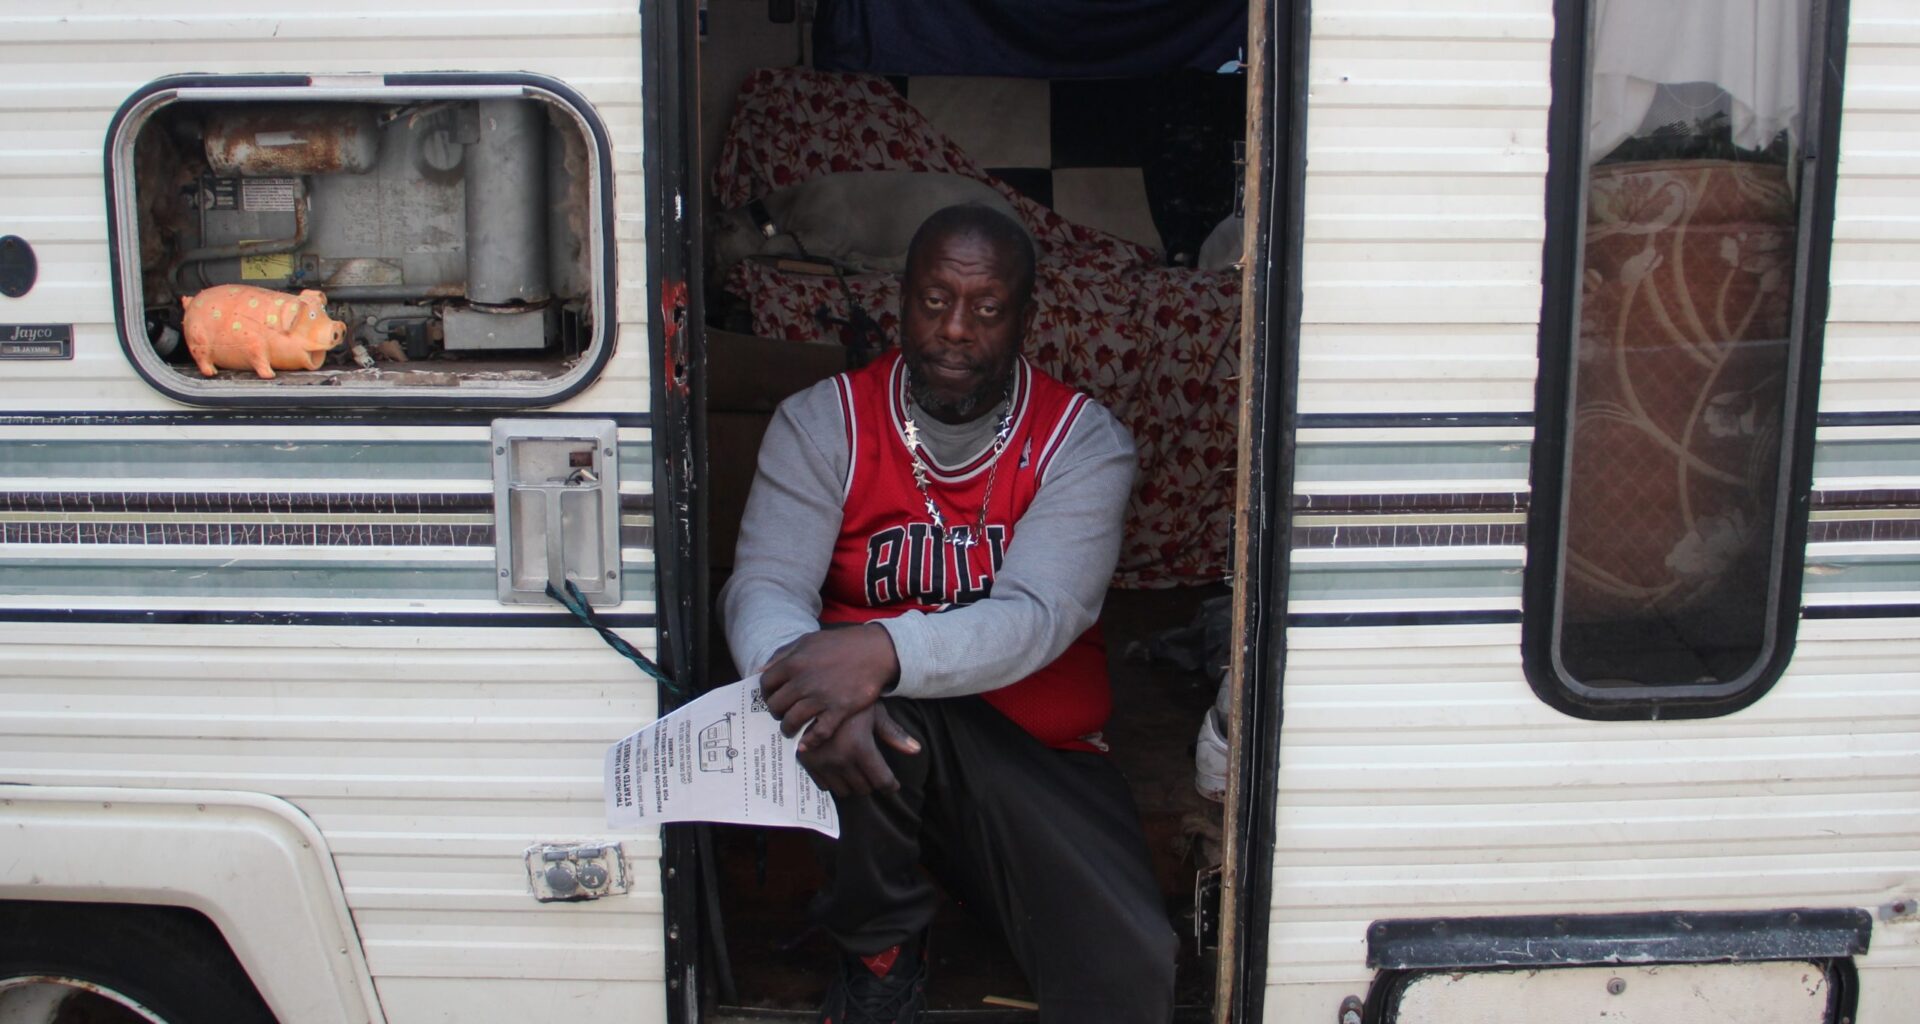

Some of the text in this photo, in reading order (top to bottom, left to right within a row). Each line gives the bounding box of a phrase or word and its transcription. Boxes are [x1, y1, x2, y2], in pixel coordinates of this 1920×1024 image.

[10, 326, 52, 341] Jayco
[614, 767, 621, 775] RV
[622, 743, 631, 773] NOVEMBER
[653, 766, 660, 774] DE
[615, 775, 624, 808] TWO-HOUR
[623, 774, 632, 807] STARTED
[654, 775, 663, 813] PROHIBICIÓN
